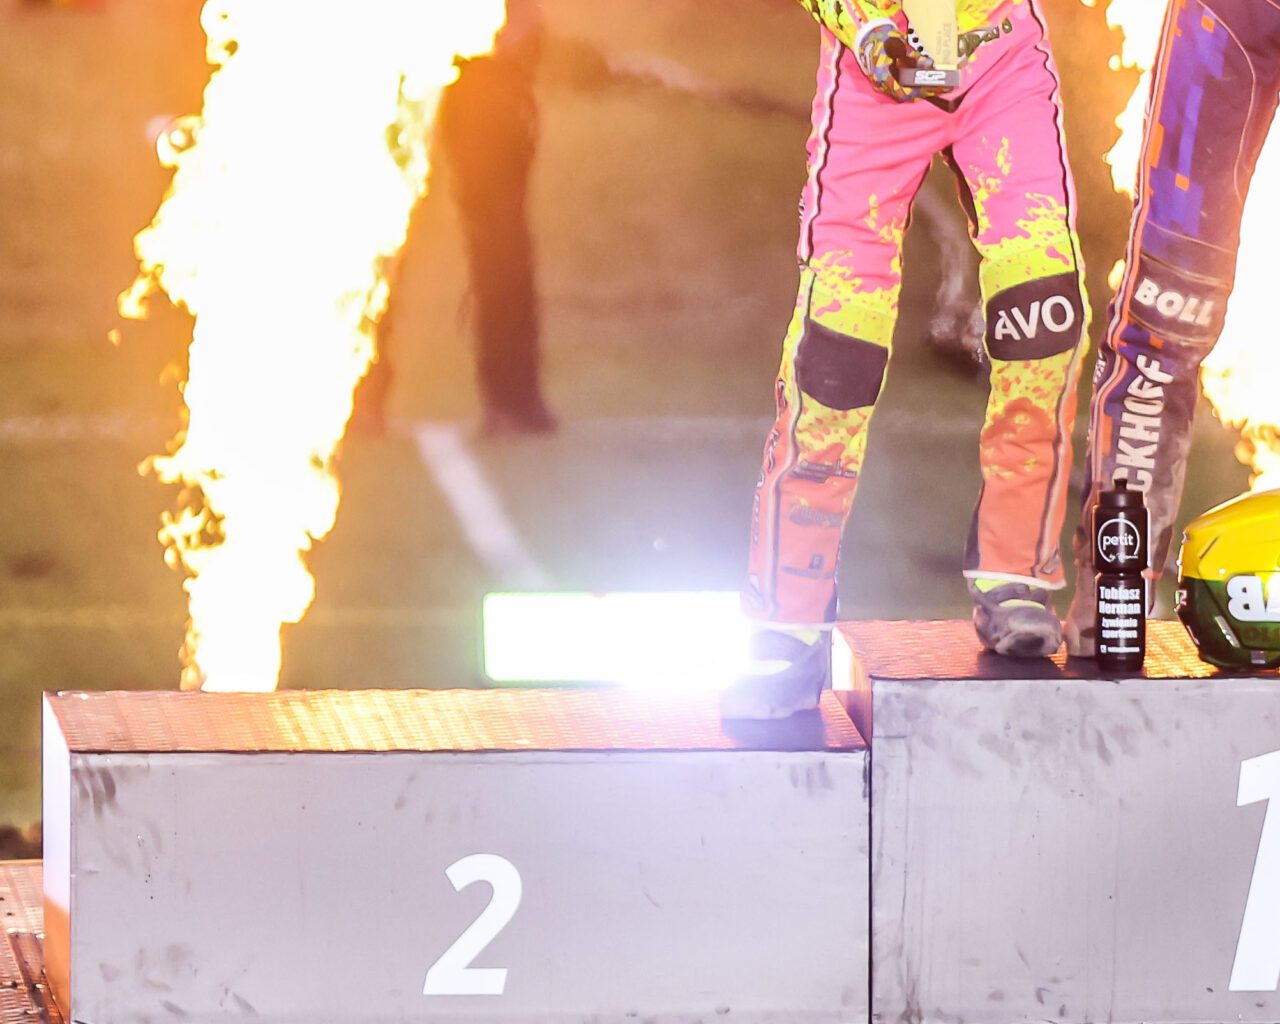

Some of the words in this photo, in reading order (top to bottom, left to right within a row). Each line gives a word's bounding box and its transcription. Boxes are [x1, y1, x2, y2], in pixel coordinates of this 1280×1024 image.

[1134, 277, 1216, 326] BOLL
[994, 295, 1075, 342] AVO
[1102, 532, 1134, 551] petit
[1098, 600, 1141, 615] Herman
[1099, 586, 1140, 600] Tobiasz
[422, 853, 522, 995] 2
